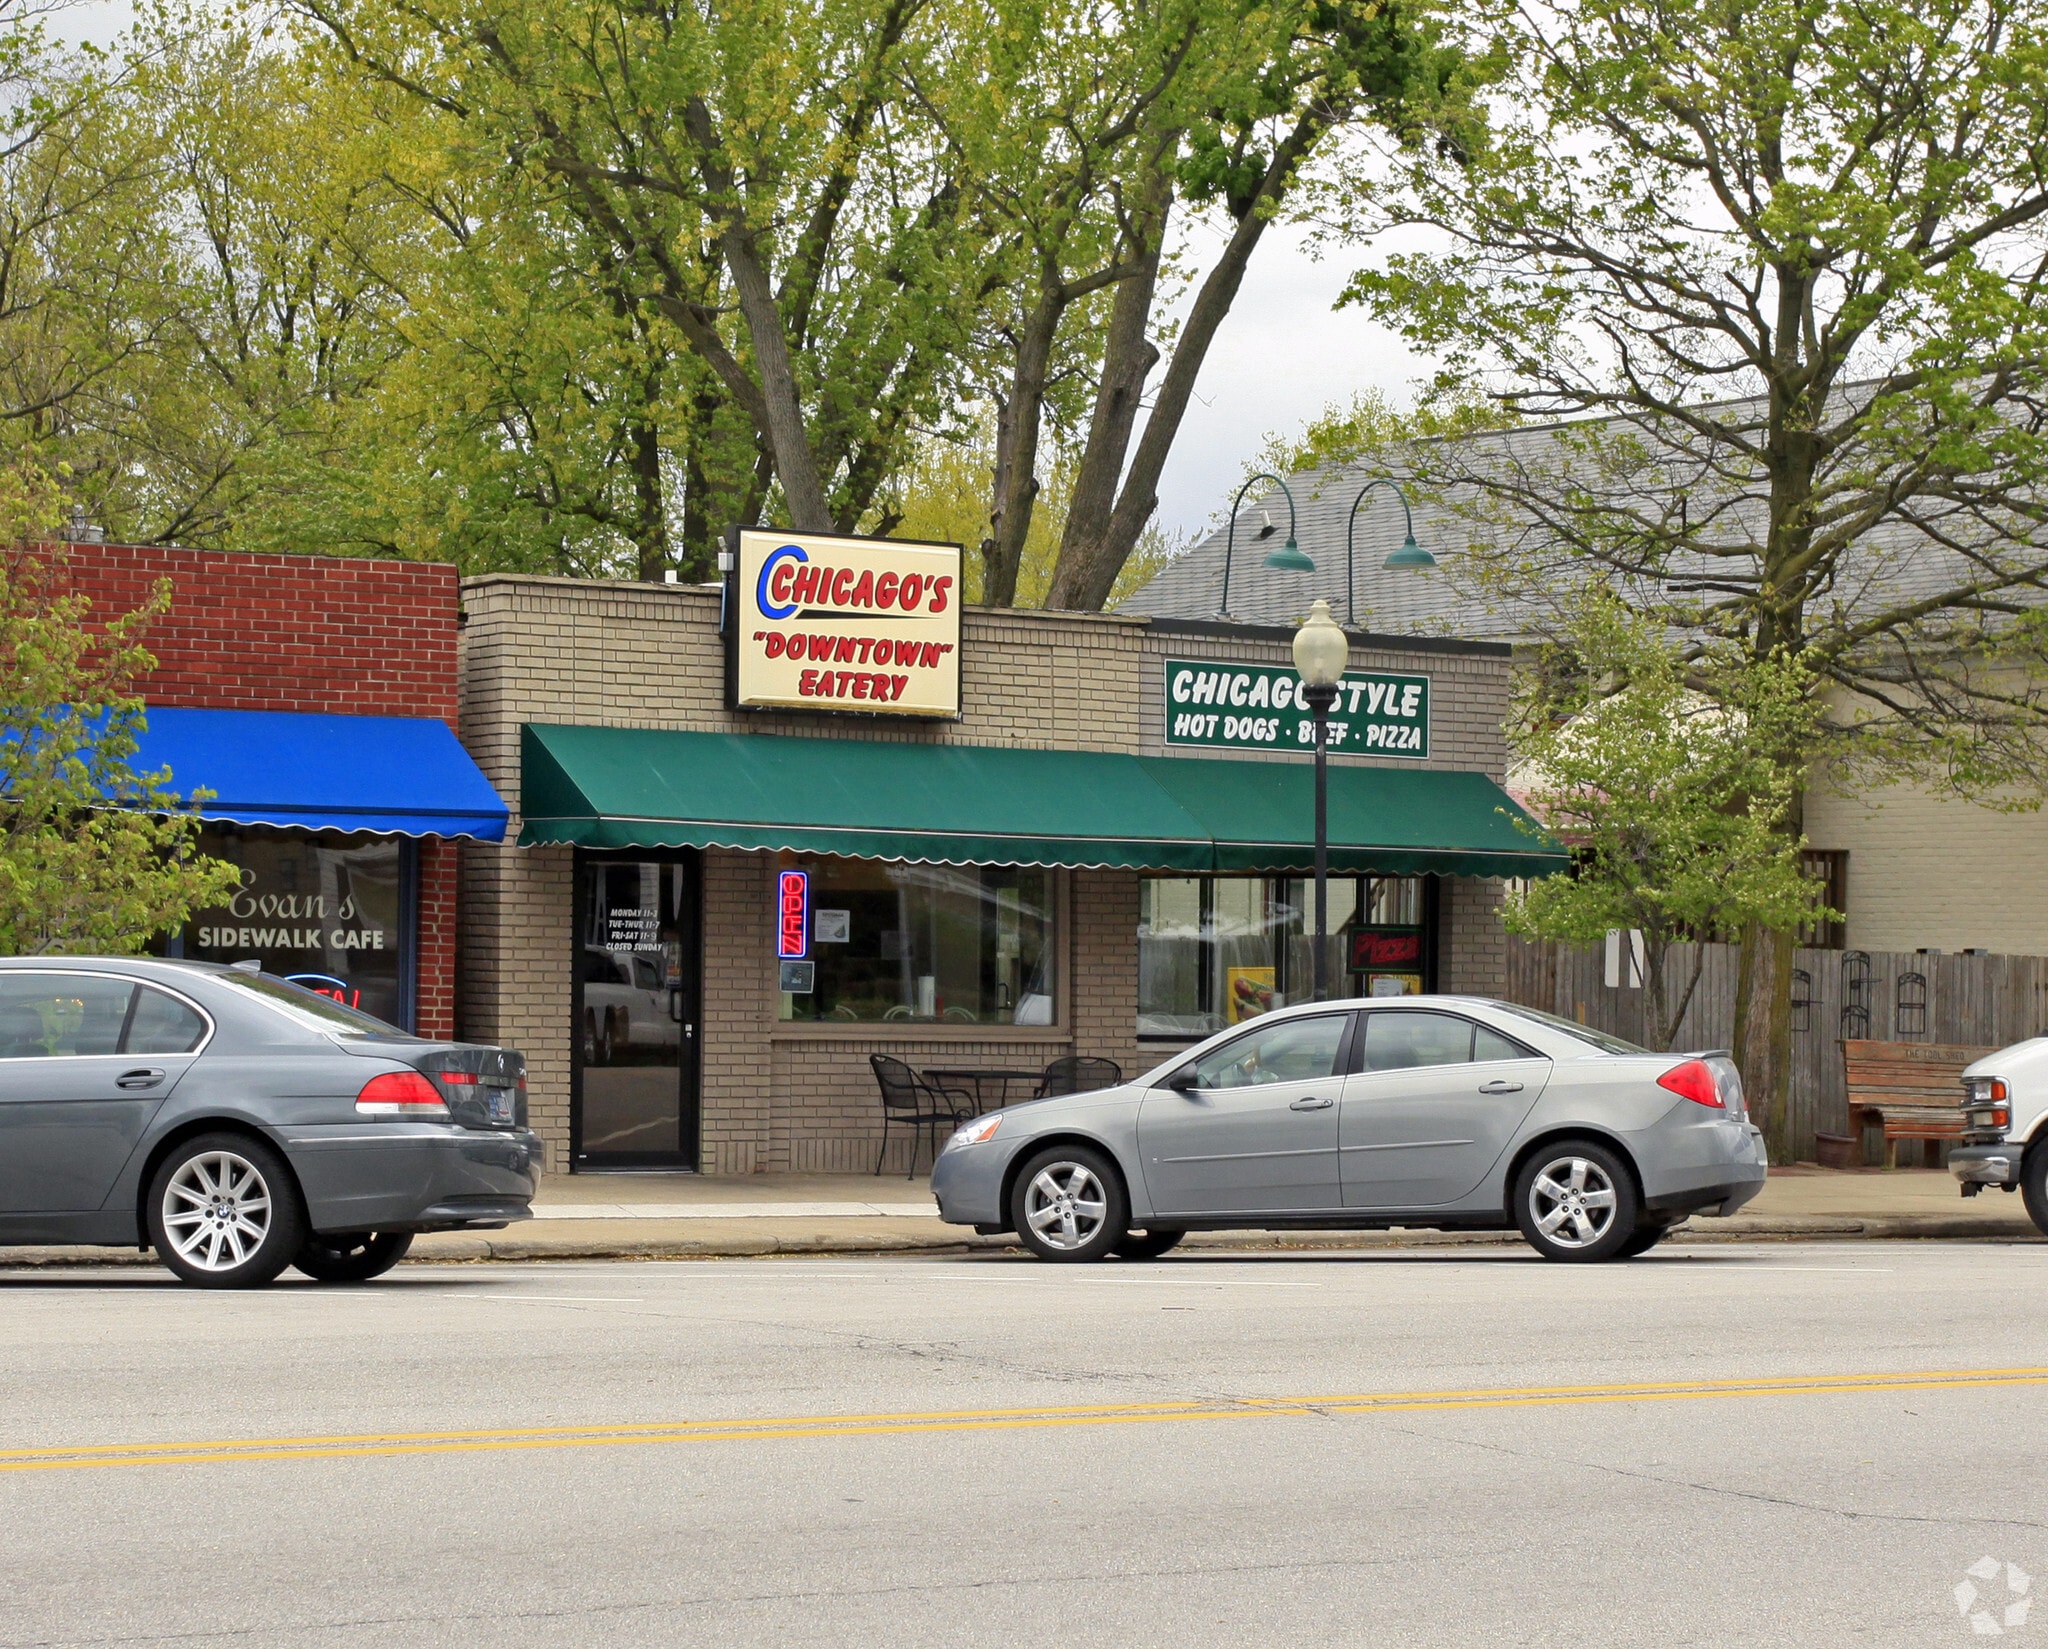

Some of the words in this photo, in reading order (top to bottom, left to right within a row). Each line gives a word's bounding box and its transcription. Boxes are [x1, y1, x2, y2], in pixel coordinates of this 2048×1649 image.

[771, 563, 953, 613] CHICAGO'S
[799, 669, 909, 702] EATERY
[1173, 713, 1219, 739] HOT
[1223, 715, 1280, 742] DOGS
[1366, 724, 1421, 750] PIZZA
[610, 908, 642, 917] MONDAY
[782, 873, 804, 955] OPEN
[611, 931, 639, 940] FRI-SAT
[645, 920, 660, 929] 11-7
[198, 927, 322, 949] SIDEWALK
[330, 929, 384, 950] CAFE
[605, 942, 633, 951] CLOSED
[633, 942, 663, 951] SUNDAY
